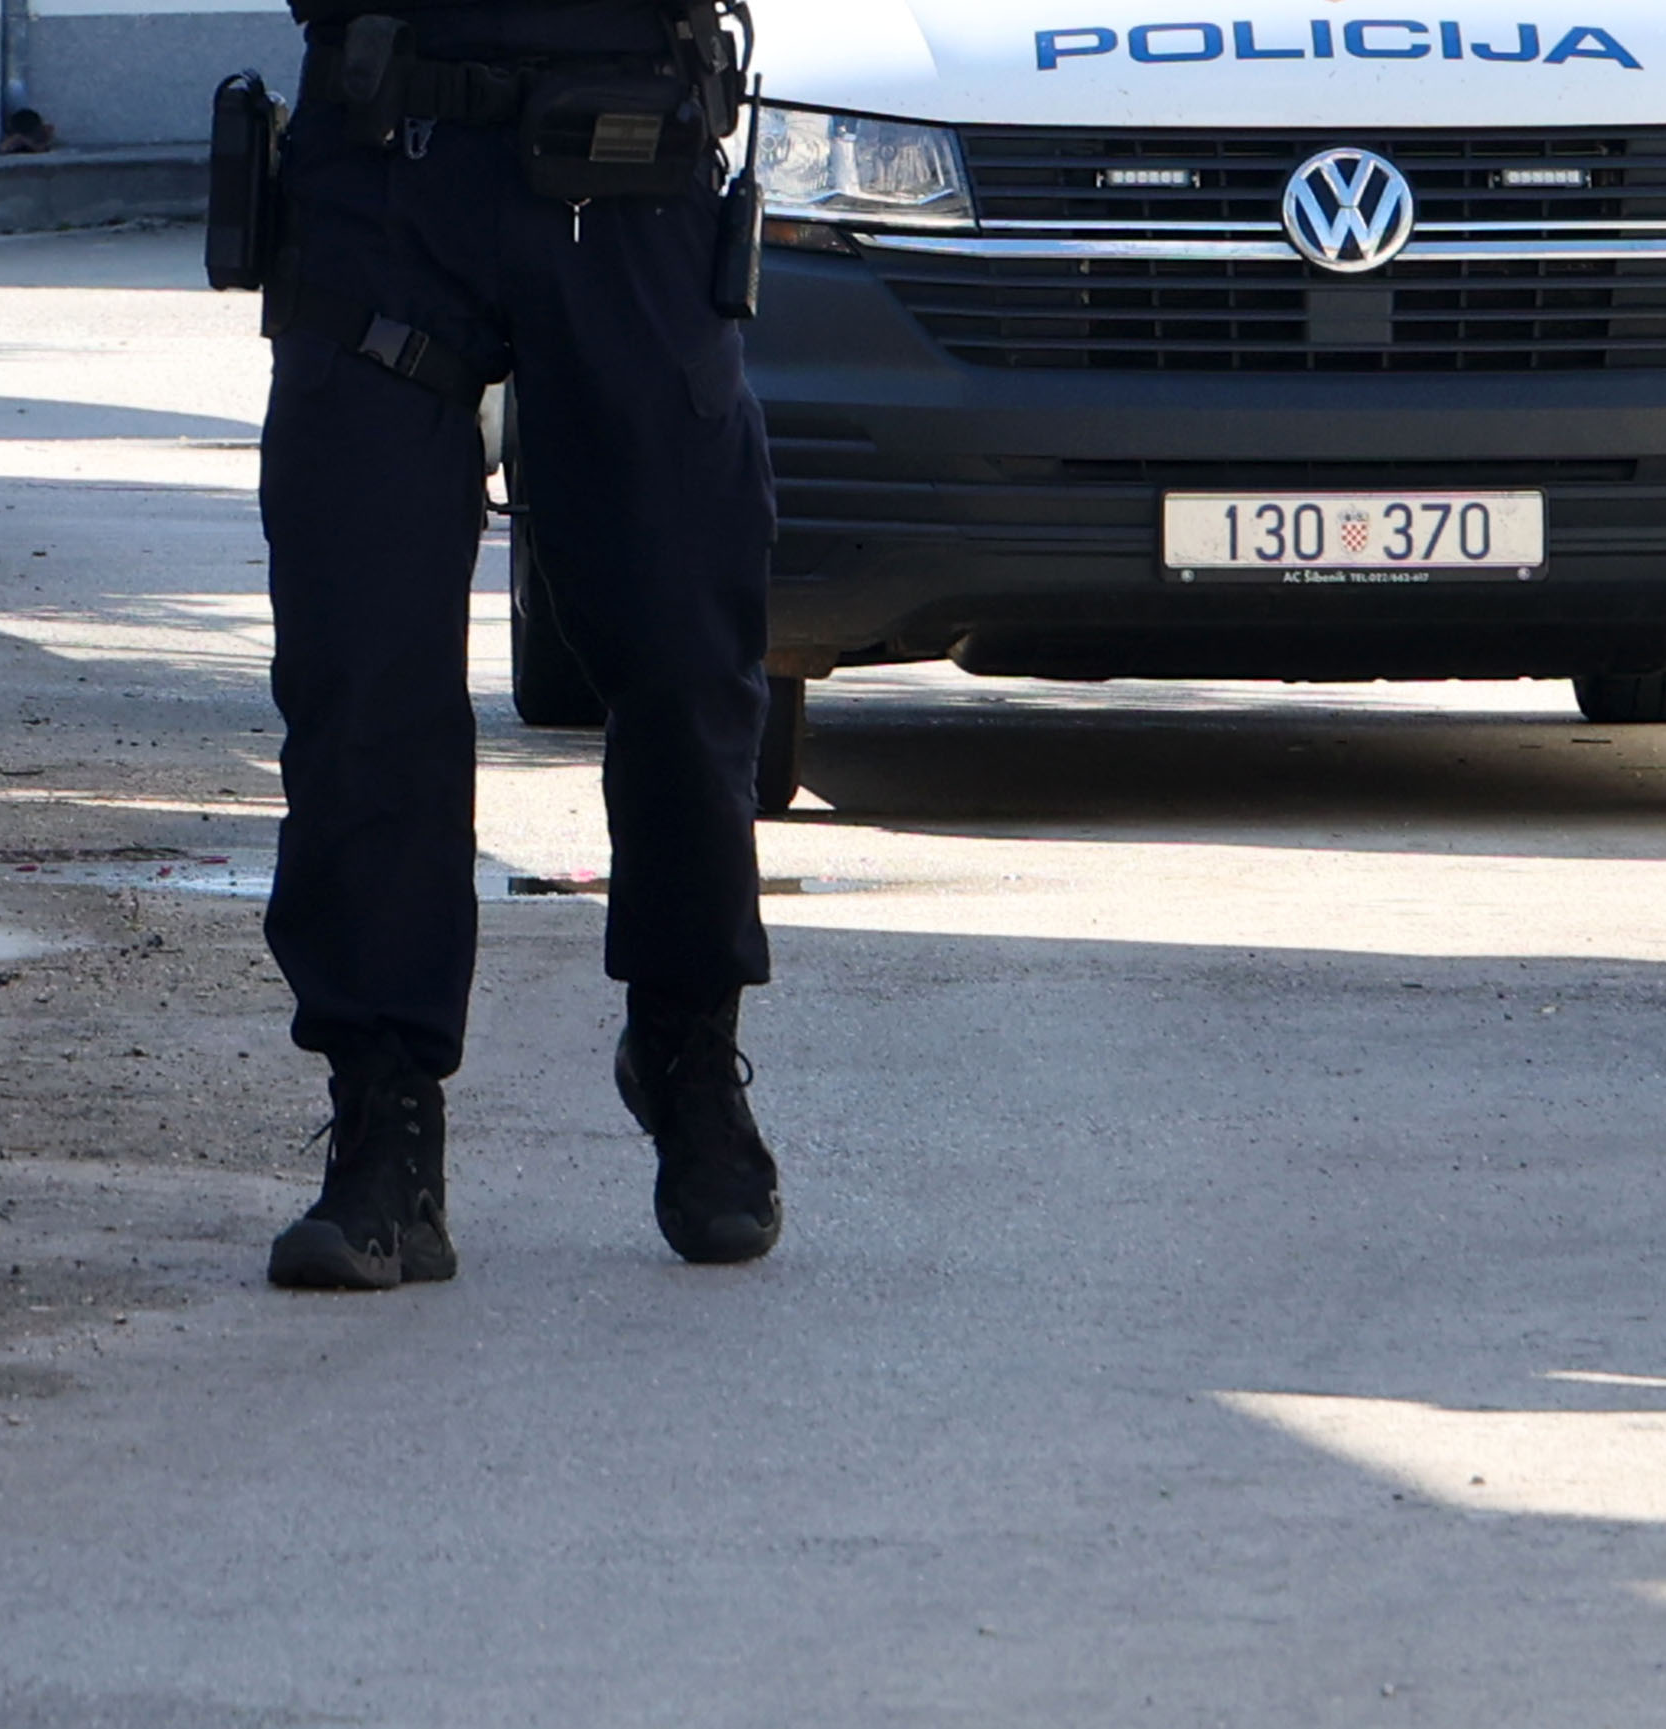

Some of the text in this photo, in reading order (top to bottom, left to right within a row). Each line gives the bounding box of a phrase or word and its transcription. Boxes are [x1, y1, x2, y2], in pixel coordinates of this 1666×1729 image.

[1034, 19, 1644, 71] POLICIJA
[1284, 148, 1413, 272] VW
[1224, 502, 1491, 561] 130 370
[1283, 571, 1302, 583] AC
